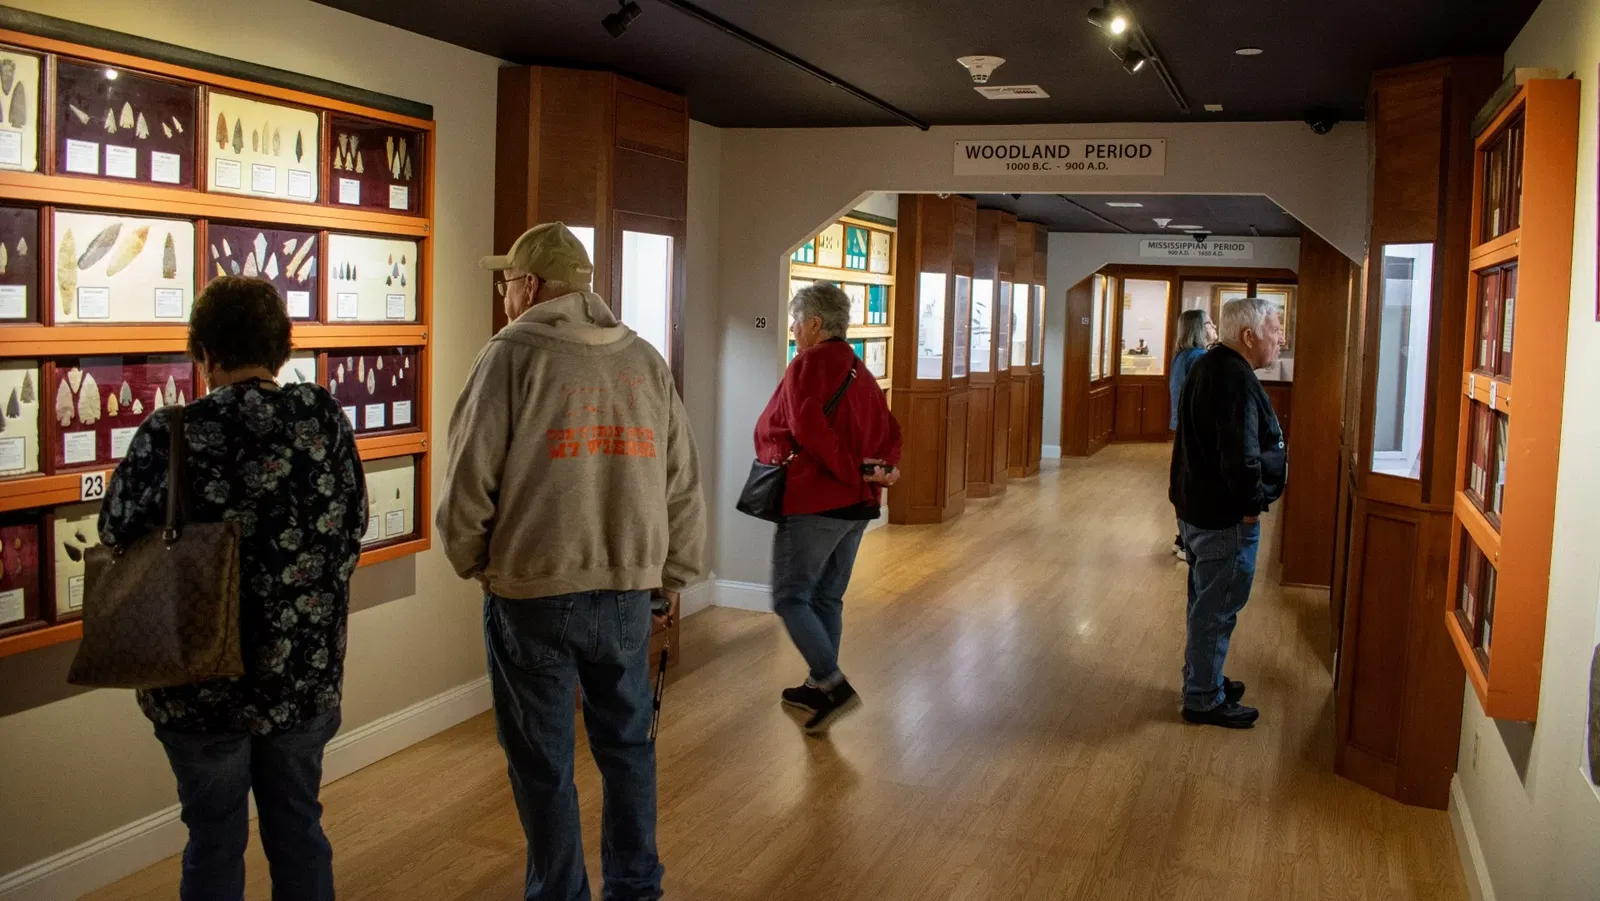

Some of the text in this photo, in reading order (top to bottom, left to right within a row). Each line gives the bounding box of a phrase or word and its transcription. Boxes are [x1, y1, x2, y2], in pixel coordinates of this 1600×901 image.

[965, 144, 1152, 159] WOODLAND PERIOD
[1006, 162, 1030, 170] 1000
[1032, 162, 1052, 170] B.C.
[1065, 162, 1084, 170] 900
[1087, 162, 1109, 170] A.D.
[1148, 242, 1245, 251] MISSISSIPPIAN PERIOD
[756, 317, 766, 328] 29
[547, 441, 581, 458] MY
[85, 475, 103, 498] 23
